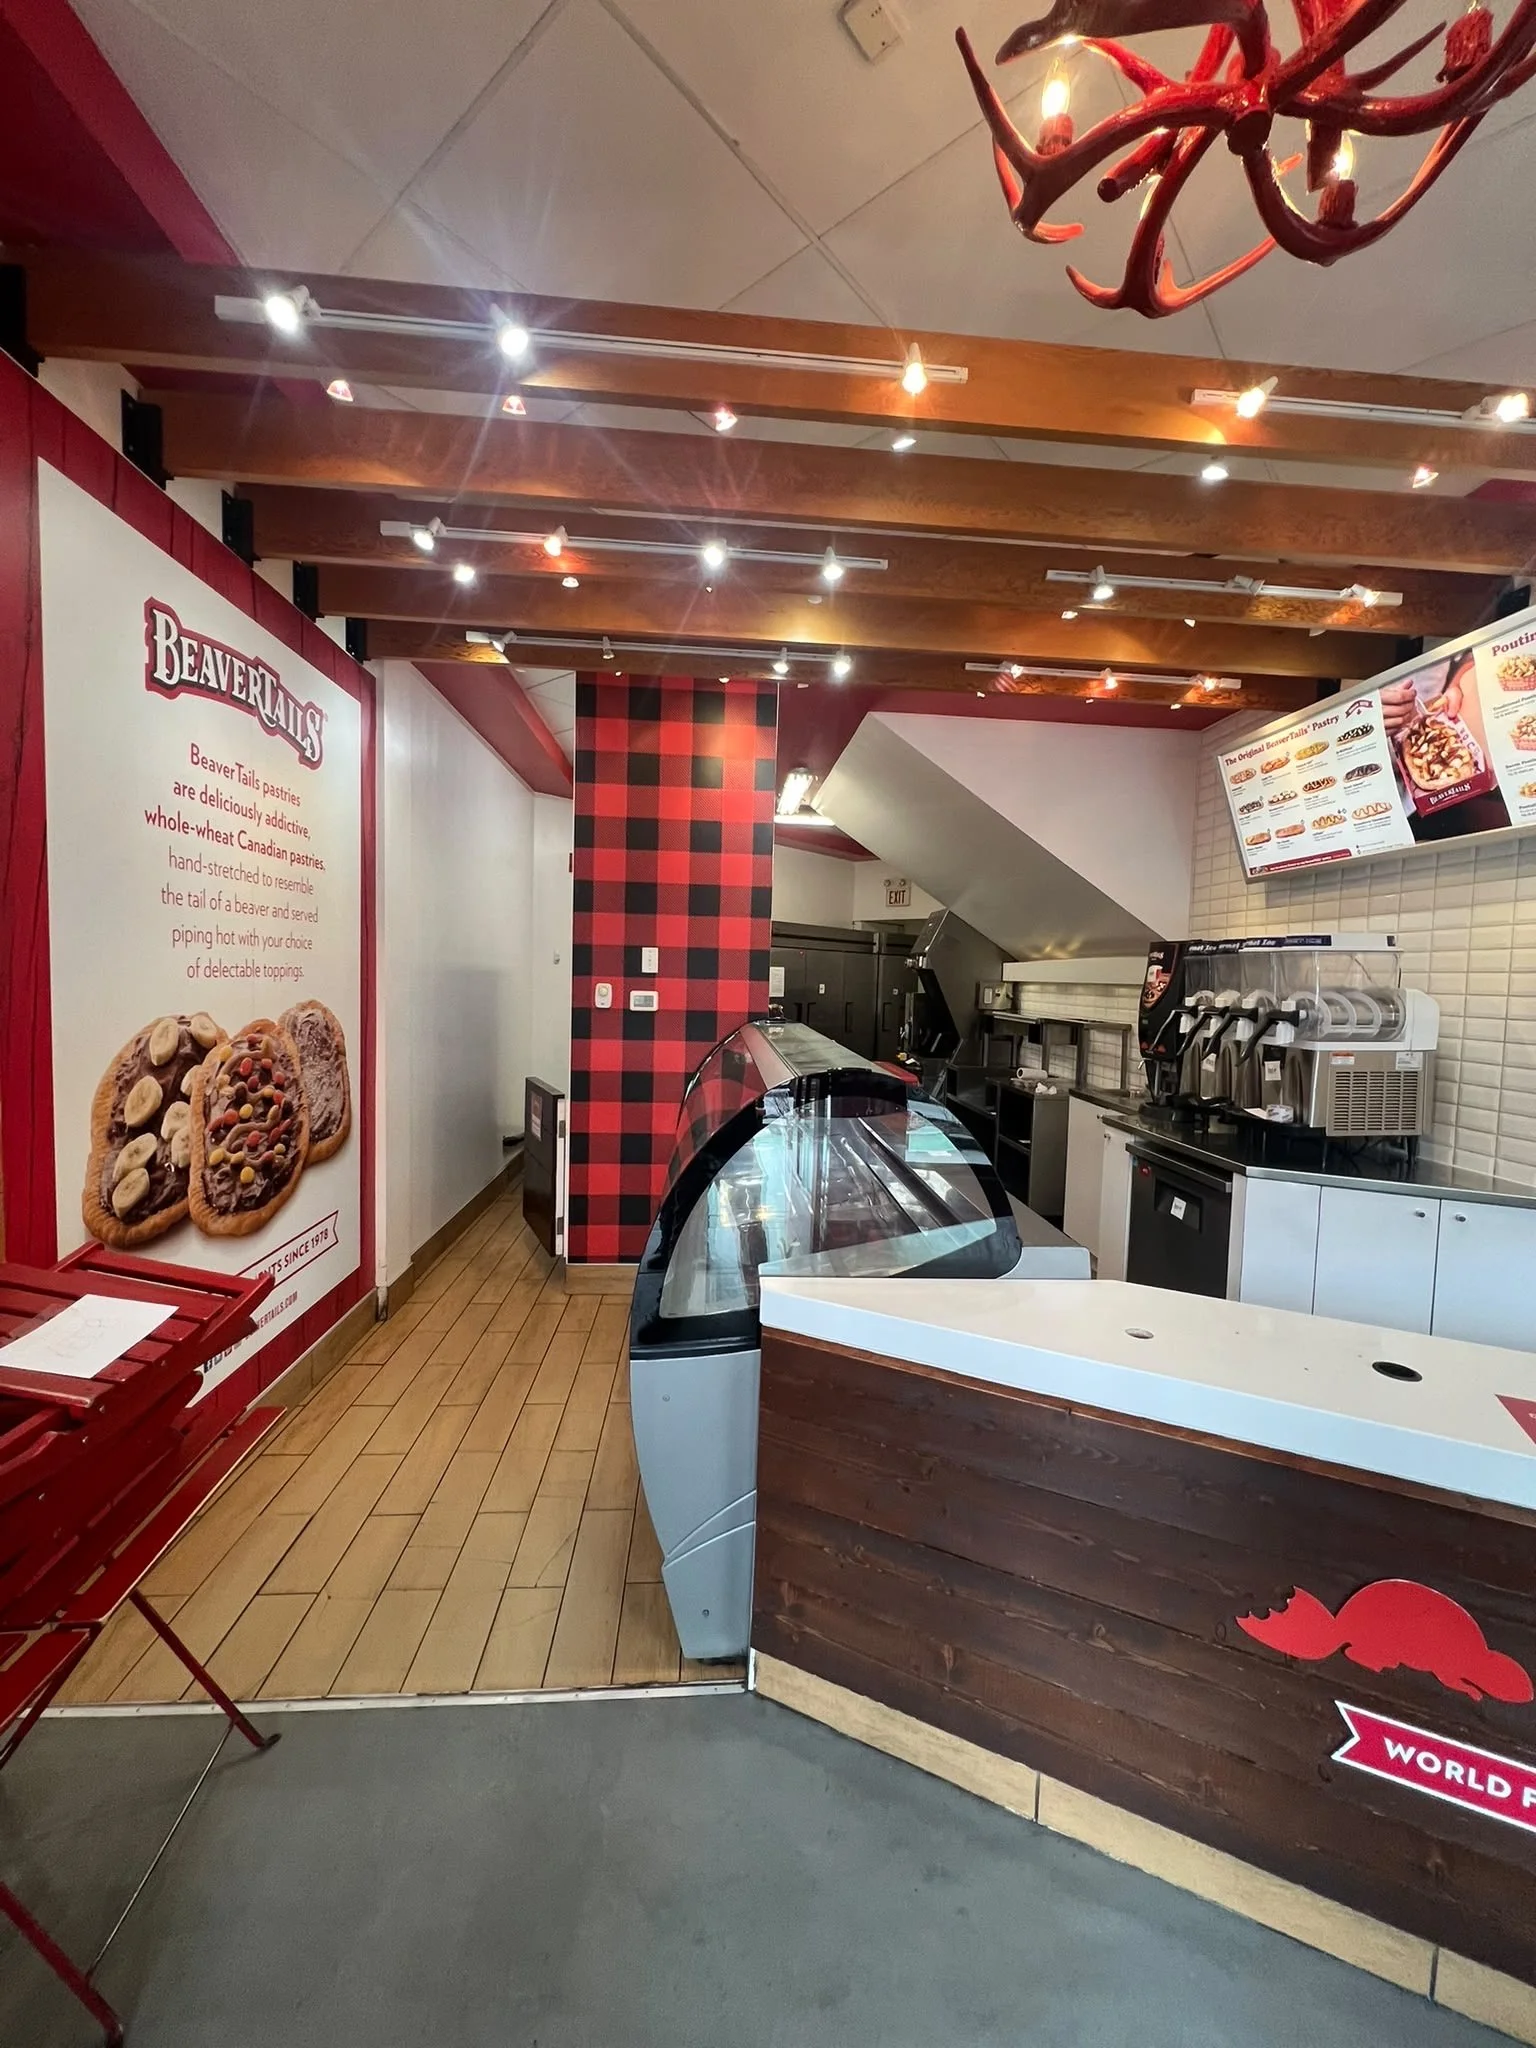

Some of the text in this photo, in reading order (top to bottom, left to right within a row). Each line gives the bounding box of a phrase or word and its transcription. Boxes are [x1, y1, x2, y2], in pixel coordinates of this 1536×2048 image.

[151, 607, 321, 763] BEAVERTAILS
[1225, 755, 1237, 767] The
[1238, 744, 1265, 762] Original
[1312, 714, 1340, 731] Pastry
[190, 742, 301, 807] BeaverTails pastries
[173, 781, 311, 840] are deliciously addictive,
[144, 805, 326, 871] whole-wheat Canadian pastries.
[168, 845, 314, 895] hand-stretched to resemble
[161, 882, 319, 923] the tail of a beaver and served
[888, 890, 906, 905] EXIT
[172, 924, 313, 952] piping hot with your choice
[186, 957, 305, 982] of delectable toppings.
[284, 1240, 310, 1268] SINCE
[311, 1227, 329, 1249] 1978
[1383, 1736, 1512, 1799] WORLD
